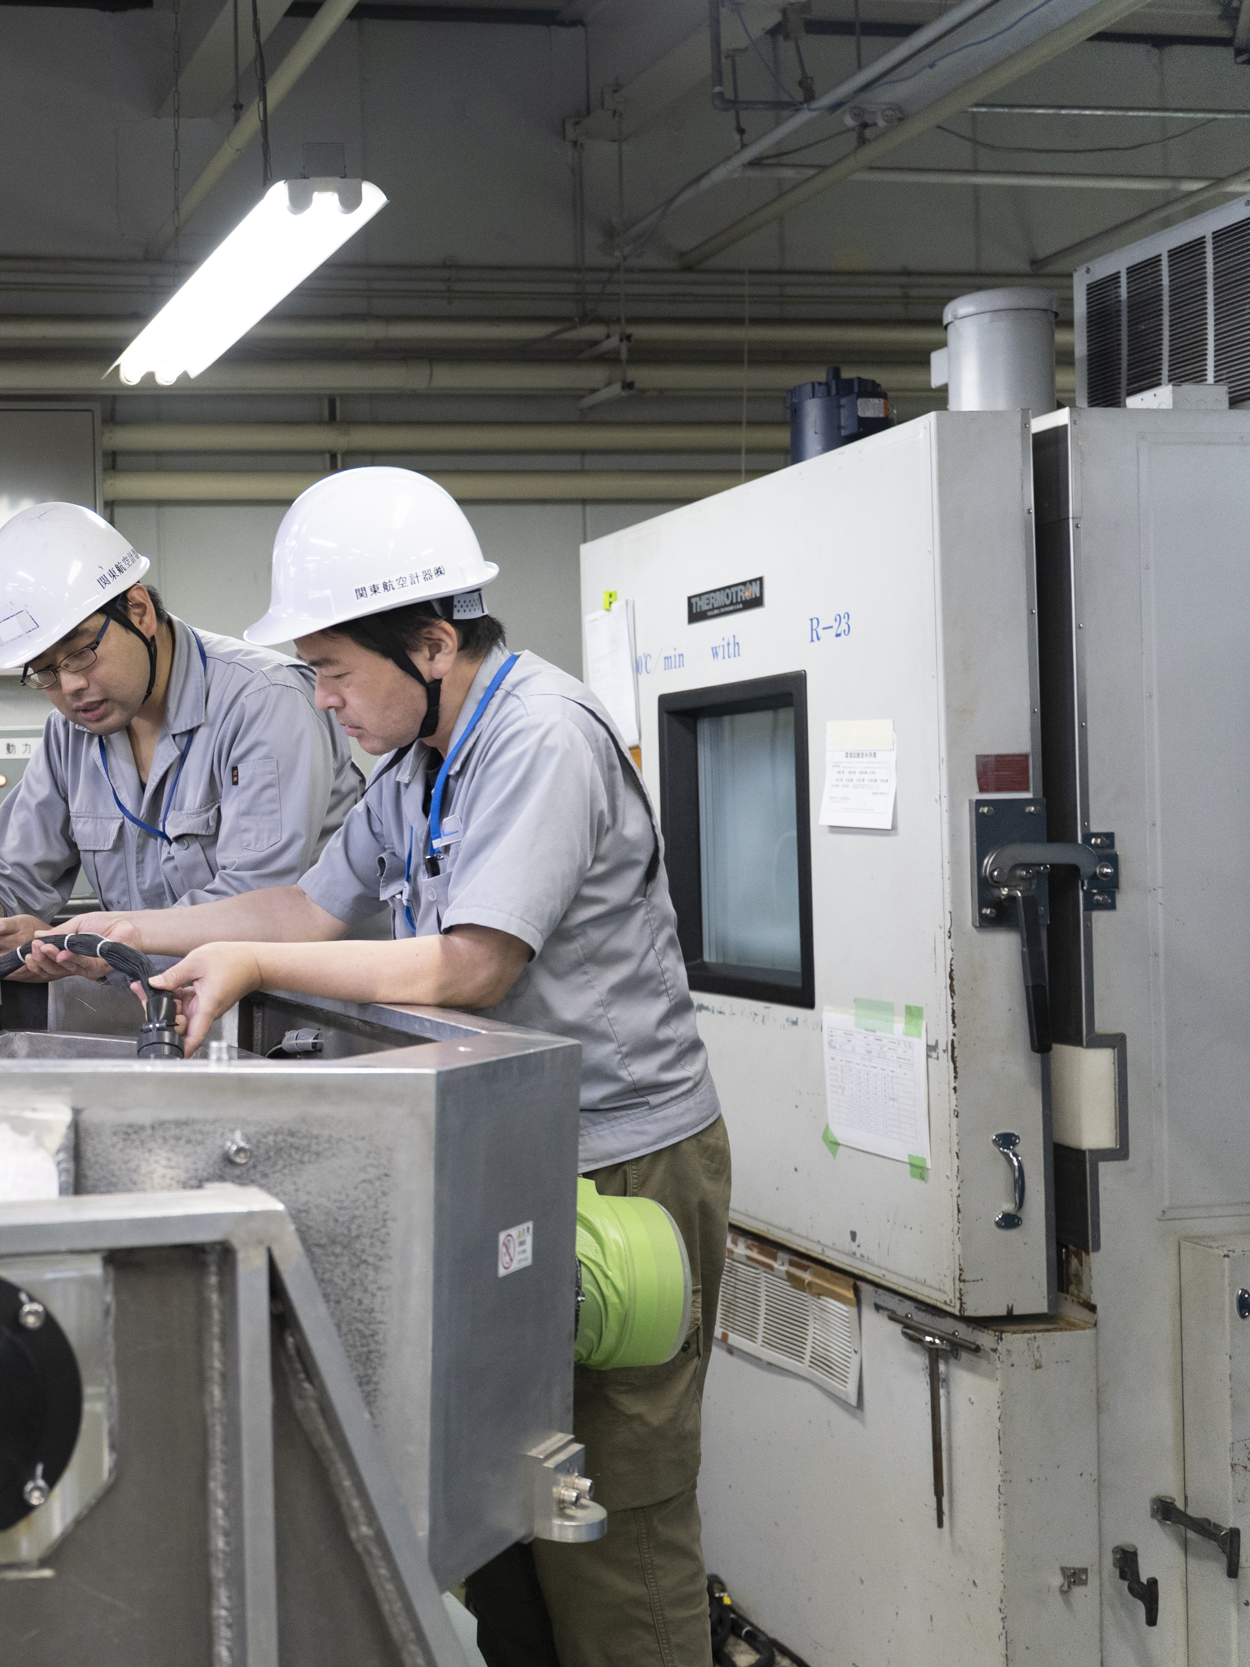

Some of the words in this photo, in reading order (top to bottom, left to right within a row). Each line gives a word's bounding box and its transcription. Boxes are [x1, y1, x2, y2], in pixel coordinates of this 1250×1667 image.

[690, 580, 761, 614] THERMOTRON
[710, 634, 742, 662] with
[808, 611, 853, 644] R-23
